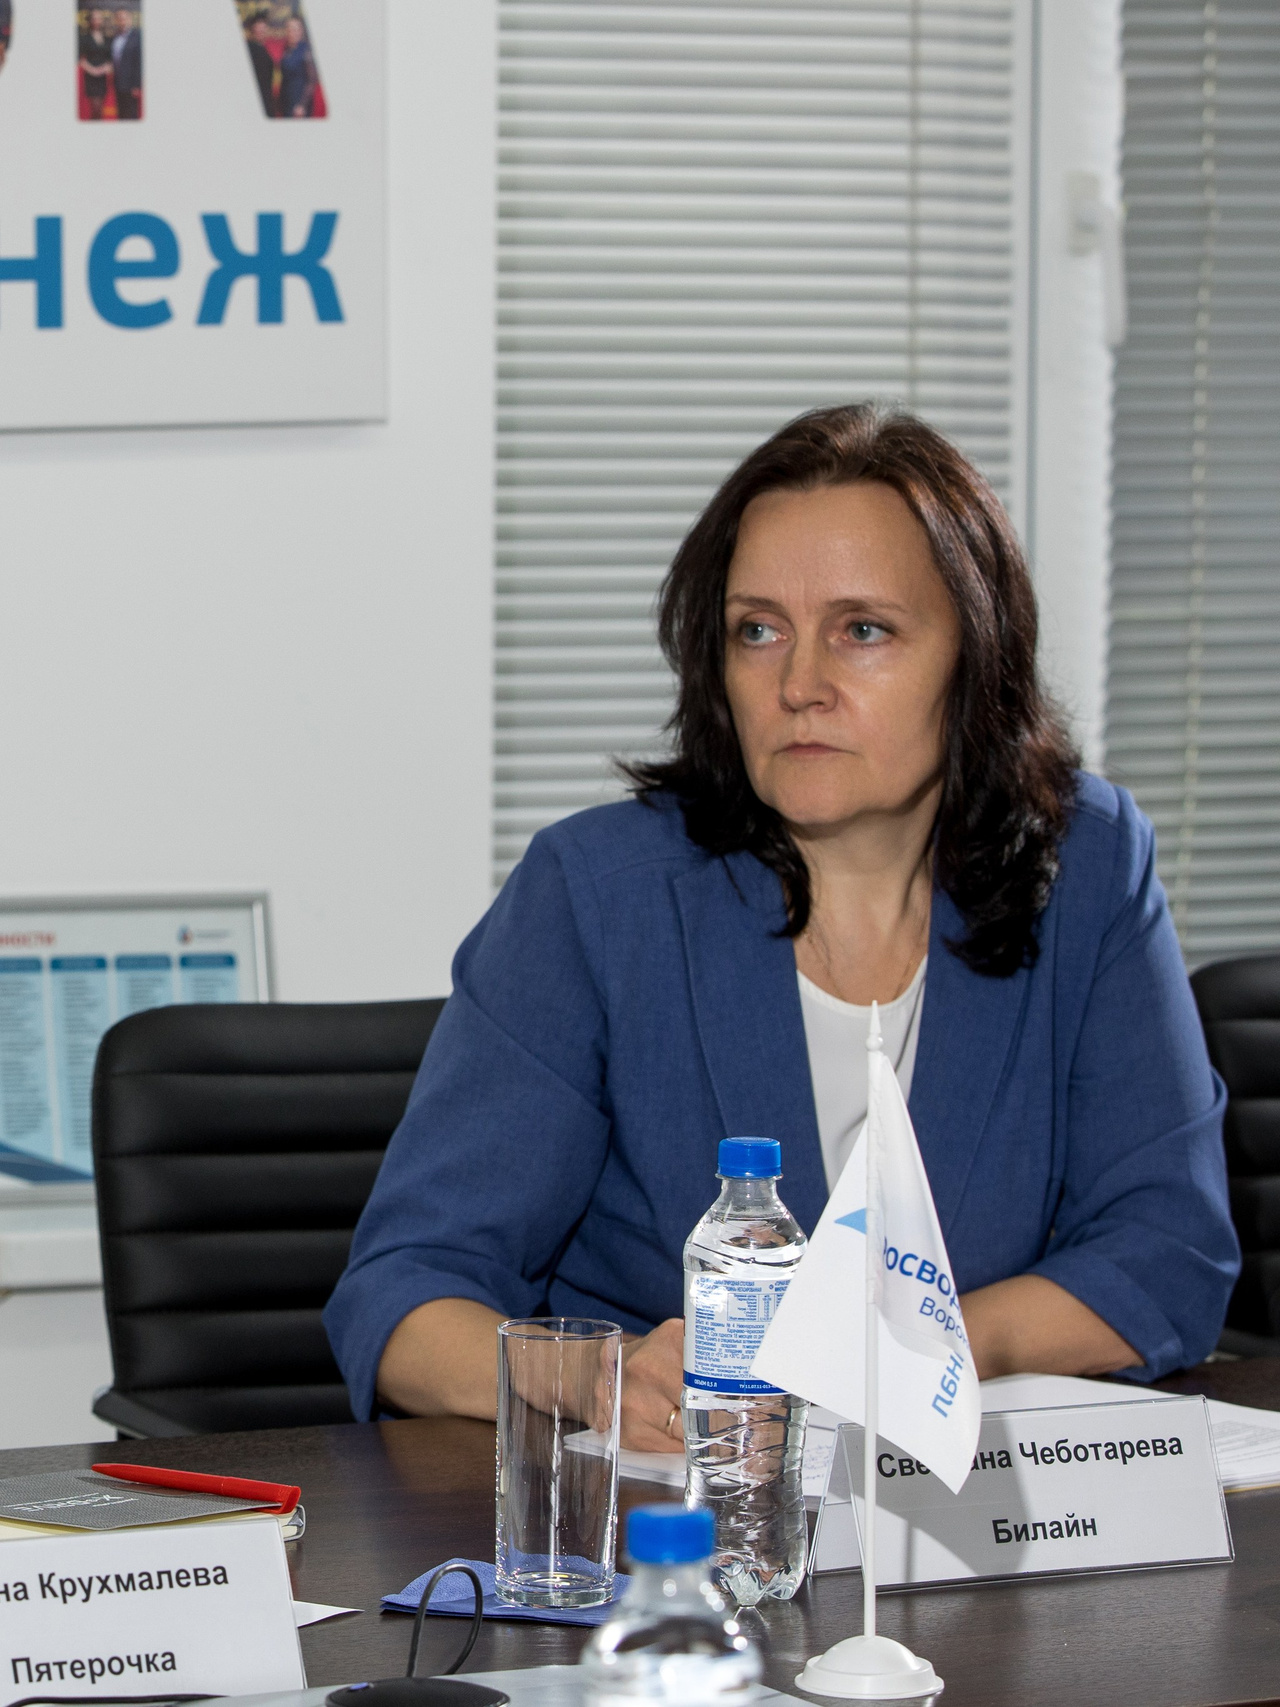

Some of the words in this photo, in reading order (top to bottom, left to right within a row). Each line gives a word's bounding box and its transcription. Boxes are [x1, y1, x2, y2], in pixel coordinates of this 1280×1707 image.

[919, 1296, 969, 1346] Воро
[877, 1450, 1012, 1478] Свеана
[1018, 1436, 1184, 1465] Чеботарева
[991, 1512, 1098, 1544] Билайн
[38, 1565, 229, 1604] Крухмалева
[11, 1650, 177, 1684] Пятерочка
